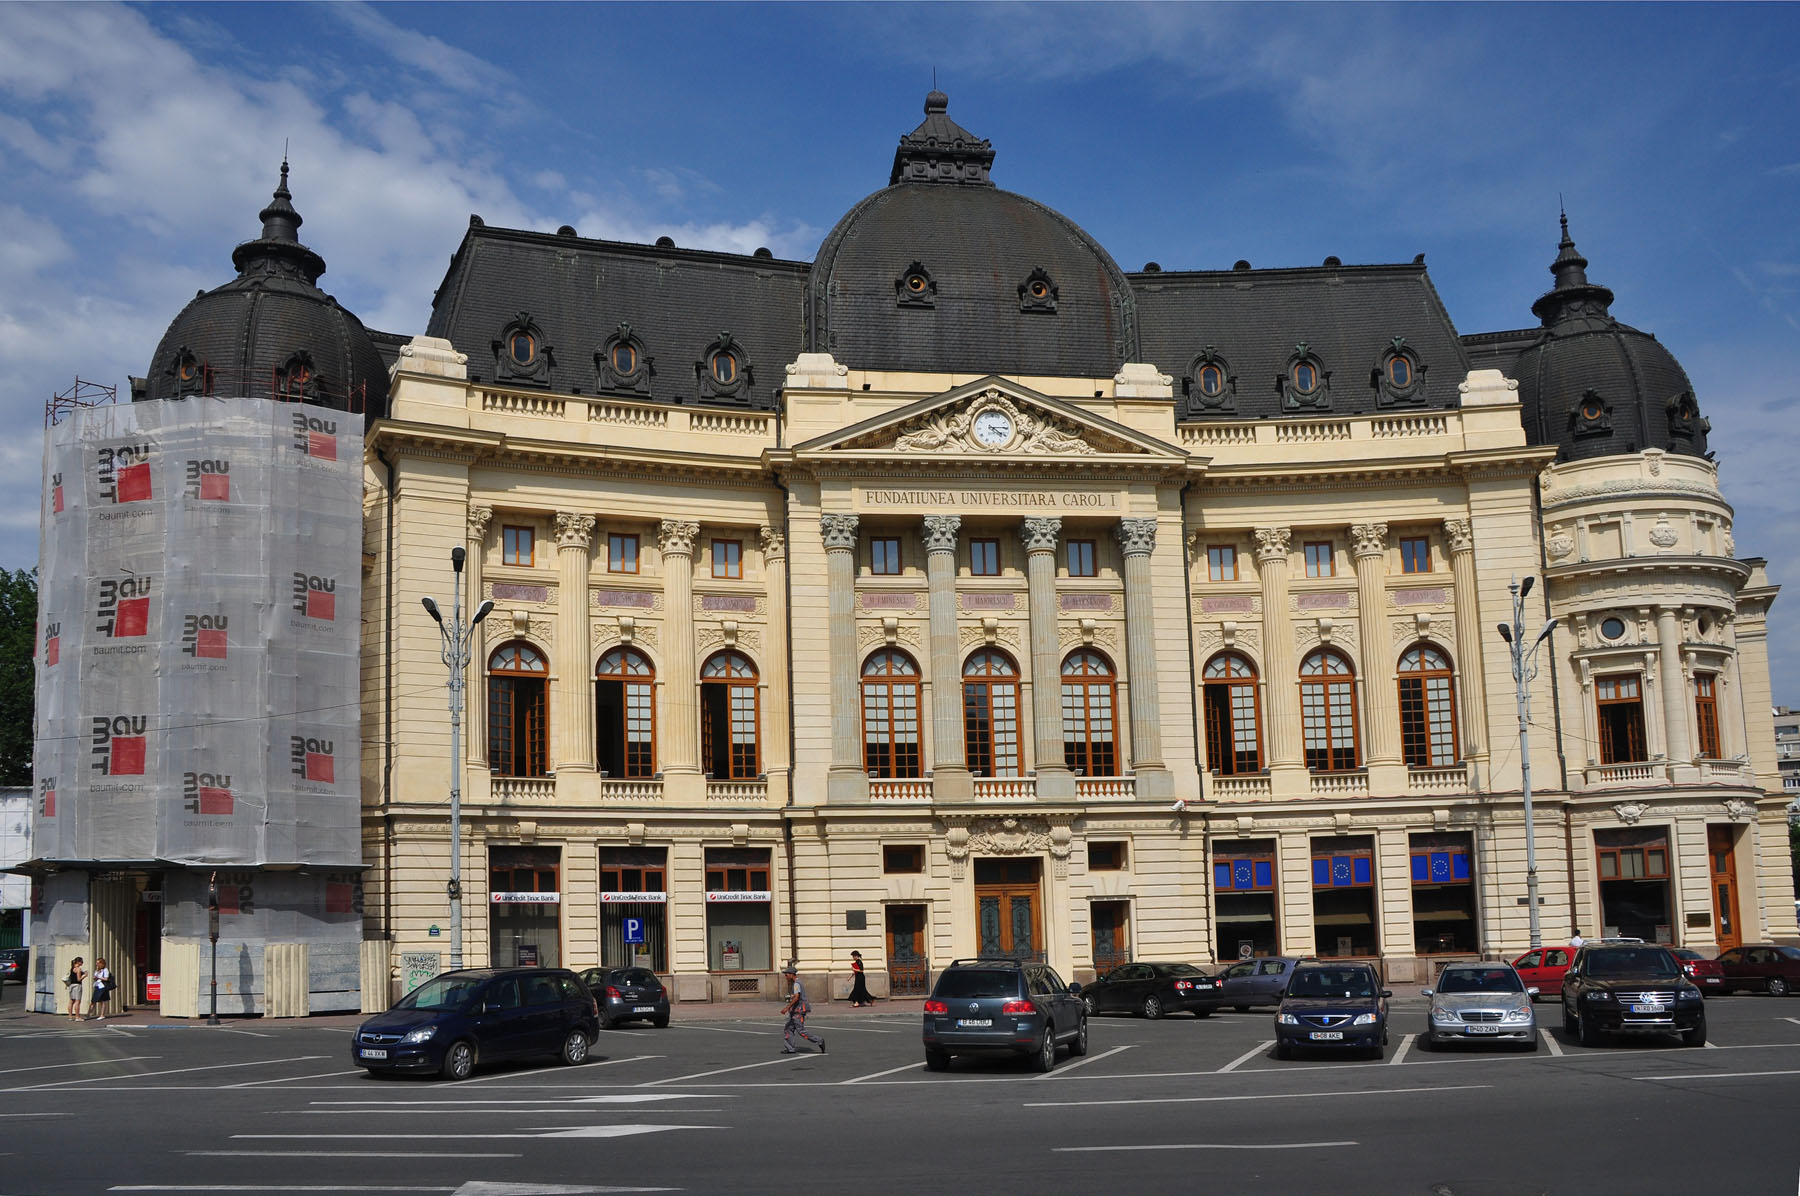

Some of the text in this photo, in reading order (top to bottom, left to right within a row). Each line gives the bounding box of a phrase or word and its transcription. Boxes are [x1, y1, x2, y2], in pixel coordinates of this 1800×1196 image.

[865, 491, 1116, 507] FUNDATIUNEA UNIVERSITARA CAROL I
[93, 644, 147, 655] baumit.com
[628, 919, 639, 940] P
